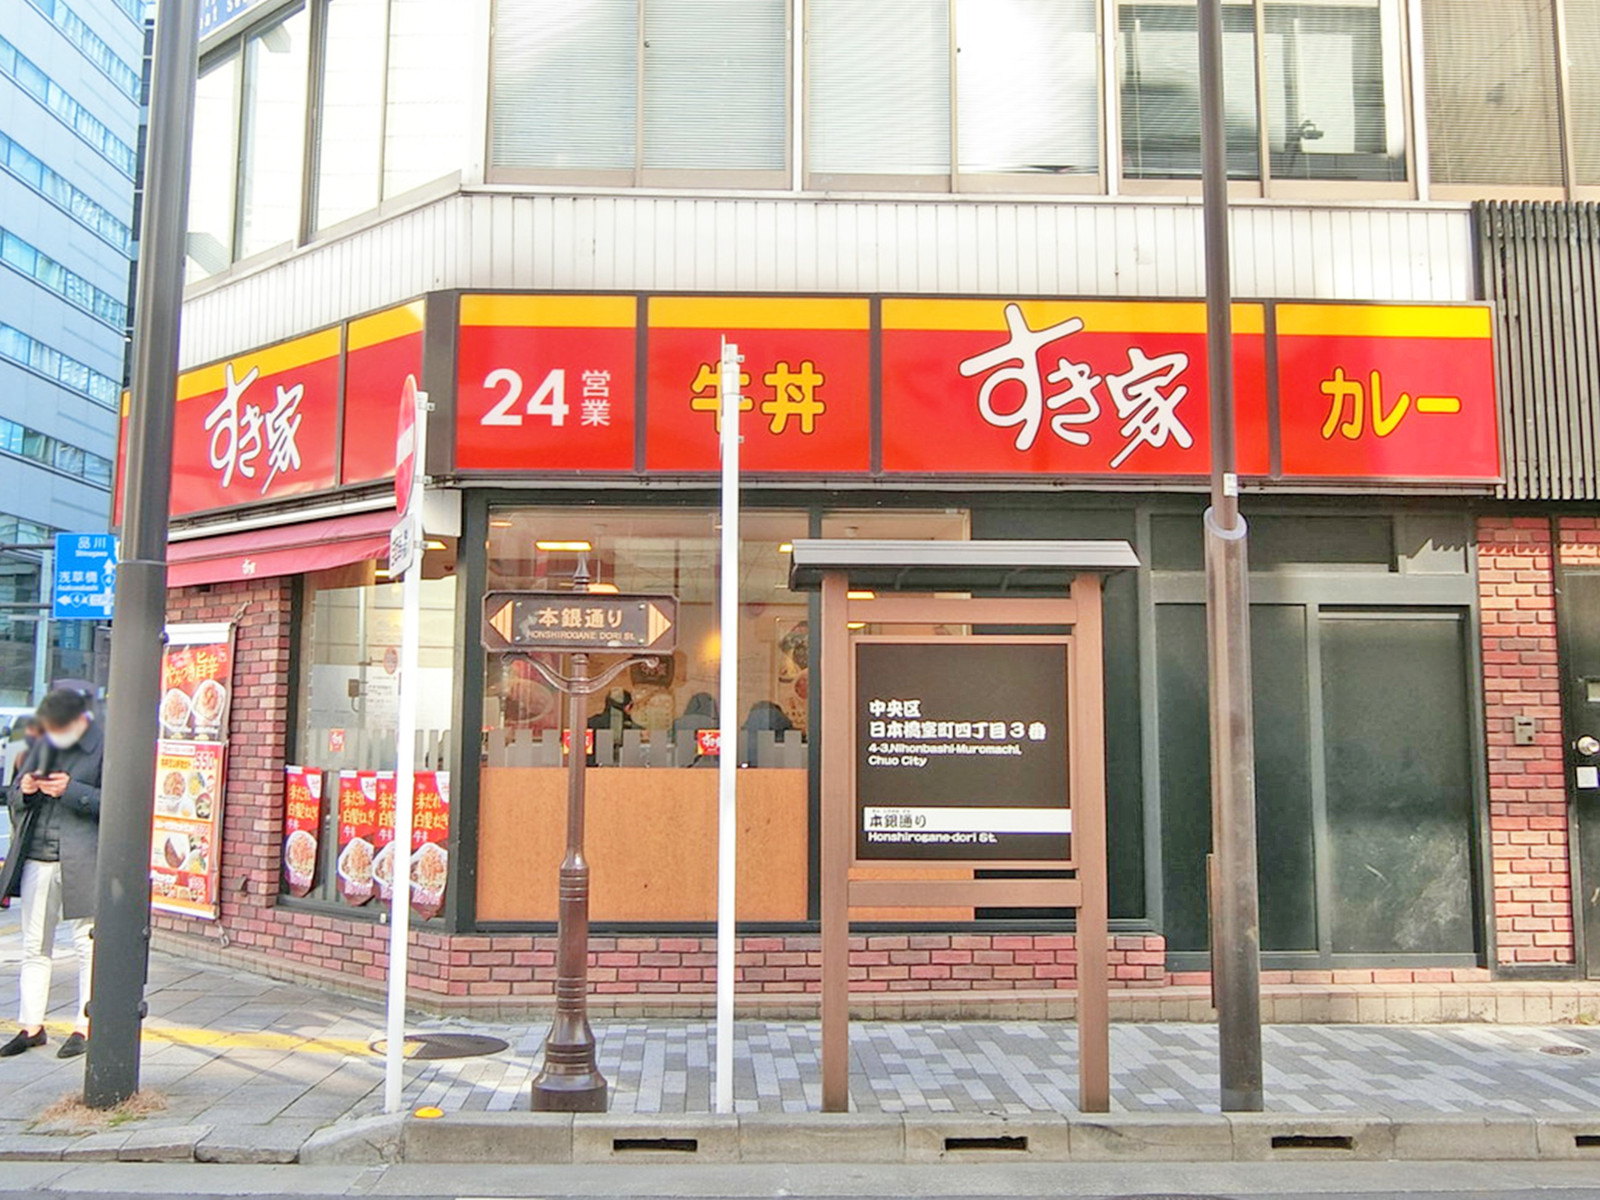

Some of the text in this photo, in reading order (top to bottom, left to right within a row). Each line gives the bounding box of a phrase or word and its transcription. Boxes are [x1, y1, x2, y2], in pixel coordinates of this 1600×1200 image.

[959, 302, 1194, 469] すき家
[480, 368, 569, 427] 24
[581, 369, 611, 427] 営業
[691, 359, 826, 434] 牛丼
[1320, 366, 1462, 440] カレー
[204, 361, 304, 495] すき家
[78, 536, 107, 549] 品川
[538, 607, 622, 628] 本銀通り
[599, 632, 622, 641] DORI
[869, 699, 921, 717] 中央区
[868, 756, 927, 768] Chuo City
[870, 814, 927, 828] 本銀通り
[868, 832, 997, 842] Honshirogane-dori St.
